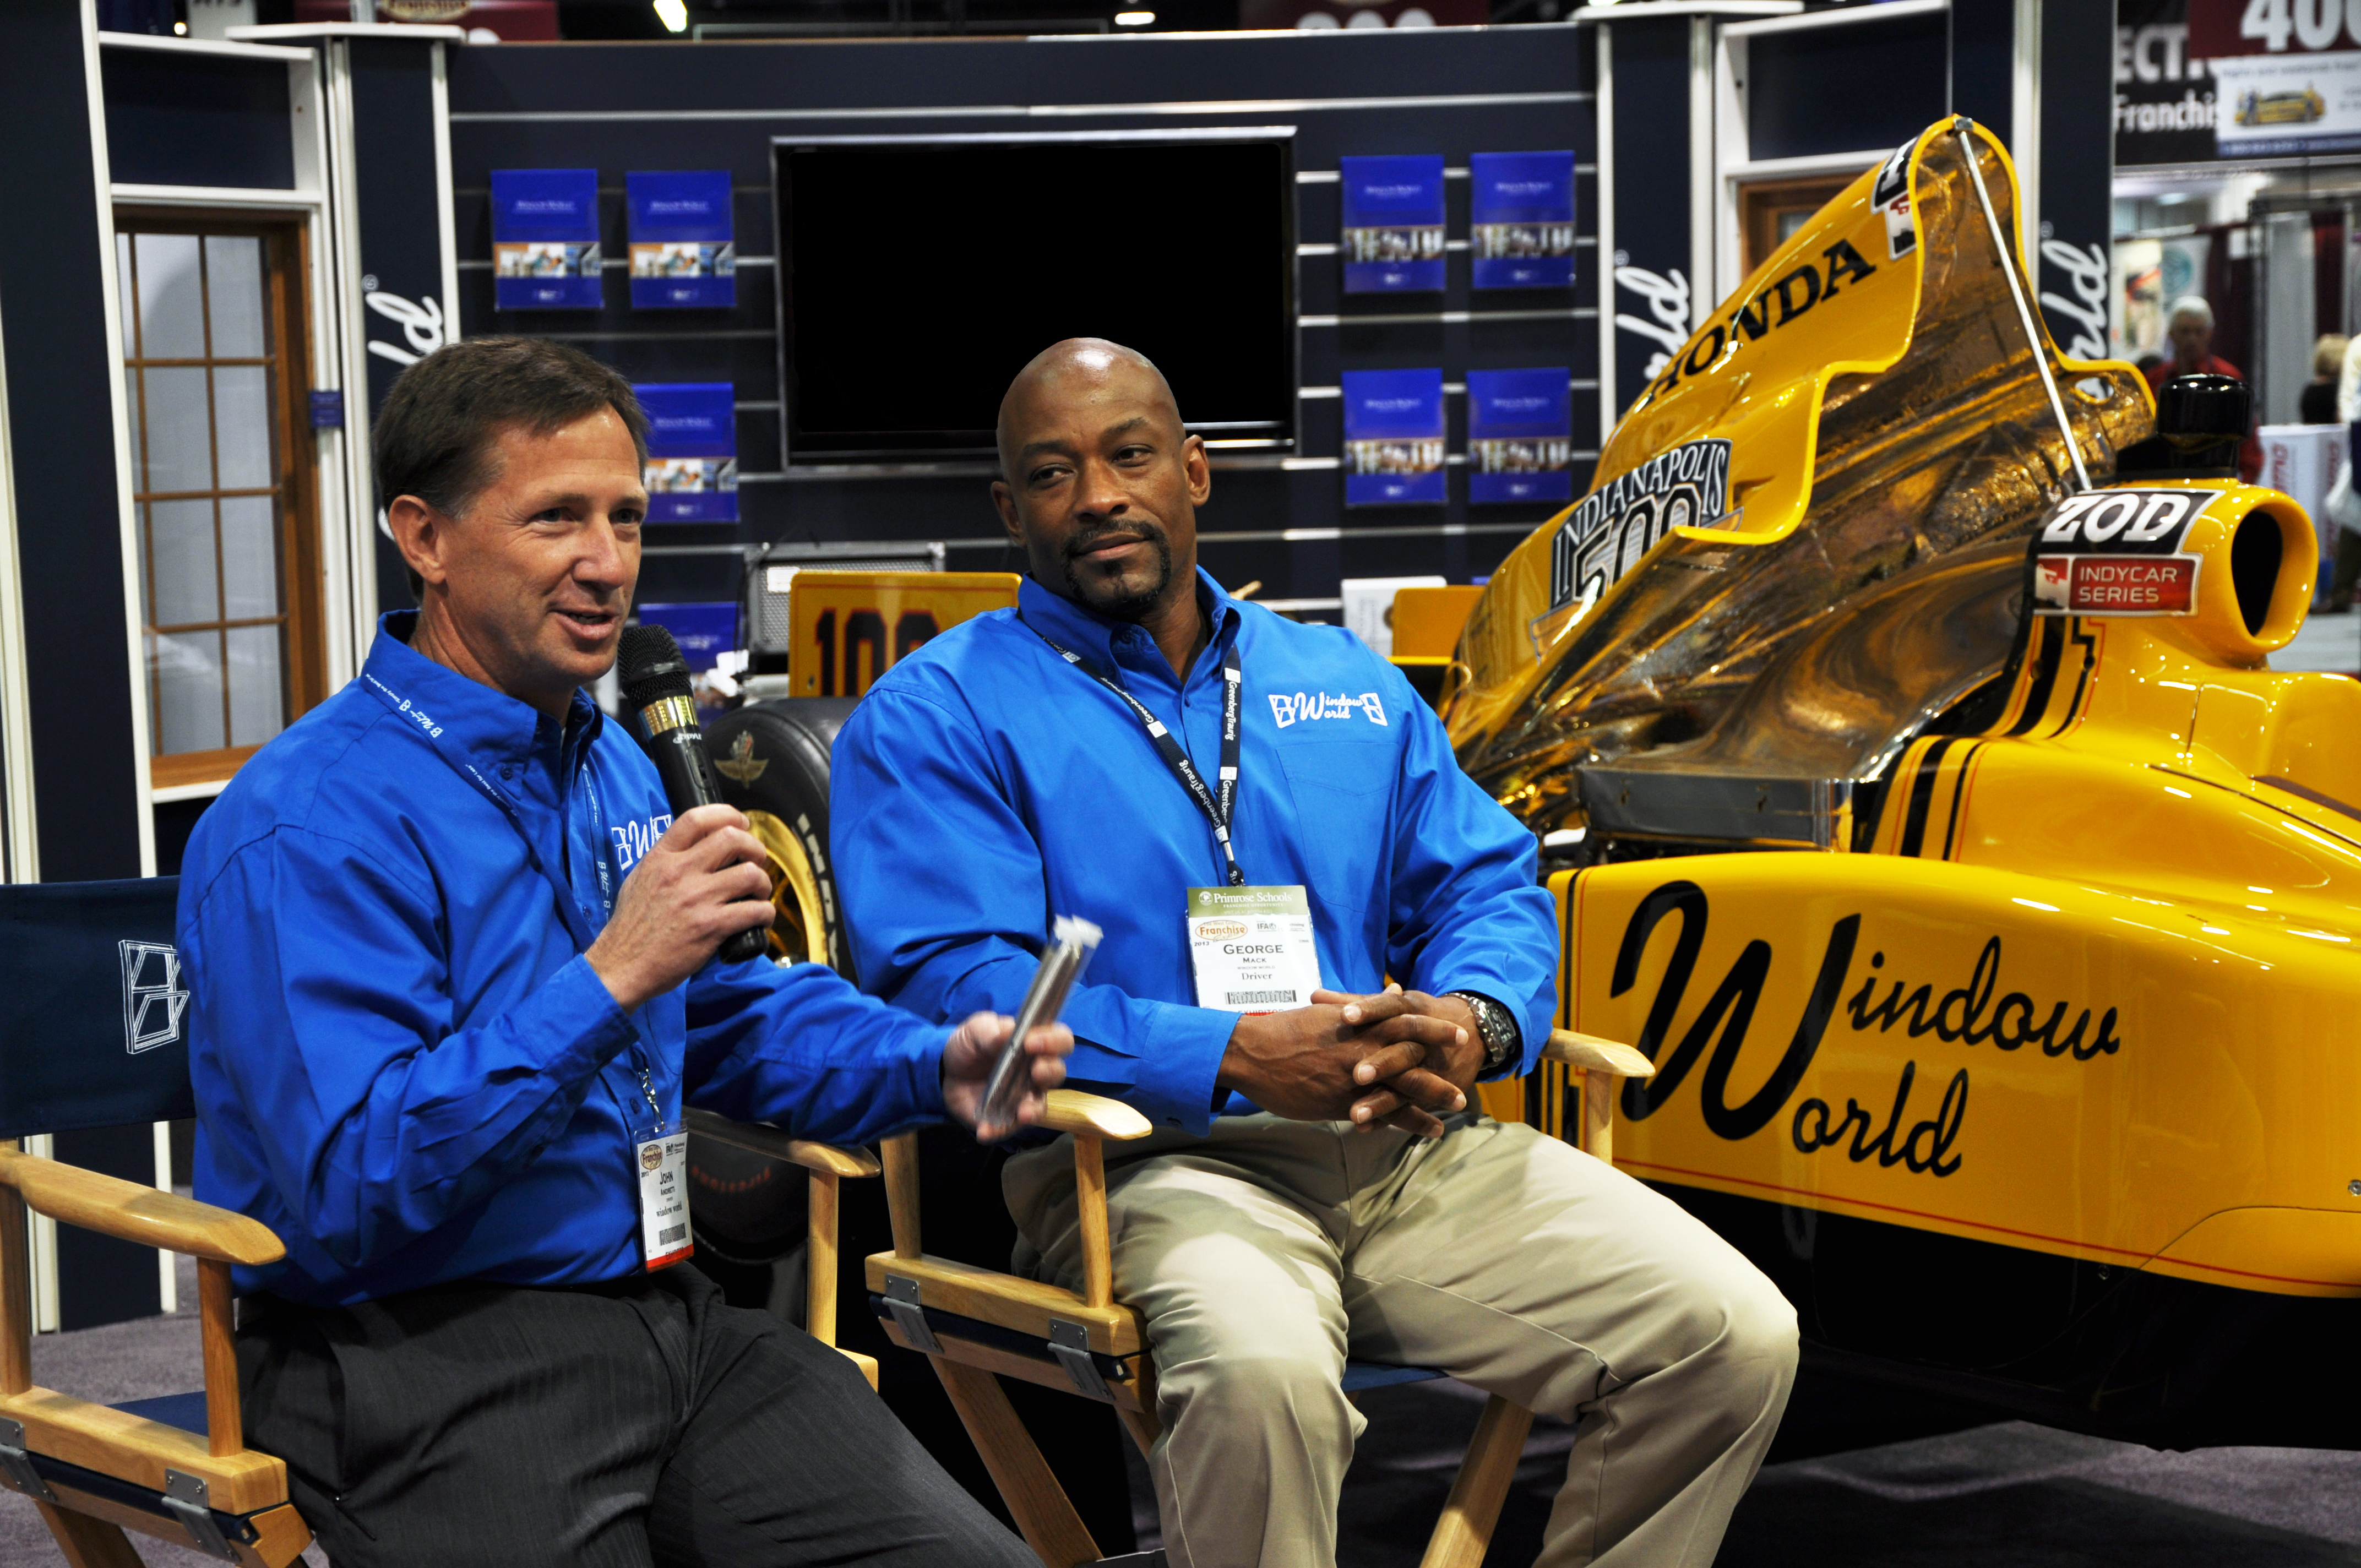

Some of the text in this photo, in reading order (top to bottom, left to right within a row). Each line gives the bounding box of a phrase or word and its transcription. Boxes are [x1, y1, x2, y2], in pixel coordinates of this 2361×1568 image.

[1651, 238, 1876, 398] HONDA
[1554, 443, 1727, 602] INDIANAPOLIS
[2041, 493, 2191, 543] ZOD
[2080, 566, 2178, 582] INDYCAR
[2079, 587, 2160, 603] SERIES
[1213, 892, 1292, 903] Primrose Schools
[1200, 925, 1245, 936] Franchise
[1223, 944, 1284, 955] GEORGE
[1241, 972, 1272, 980] Driver
[1609, 879, 2120, 1141] Window
